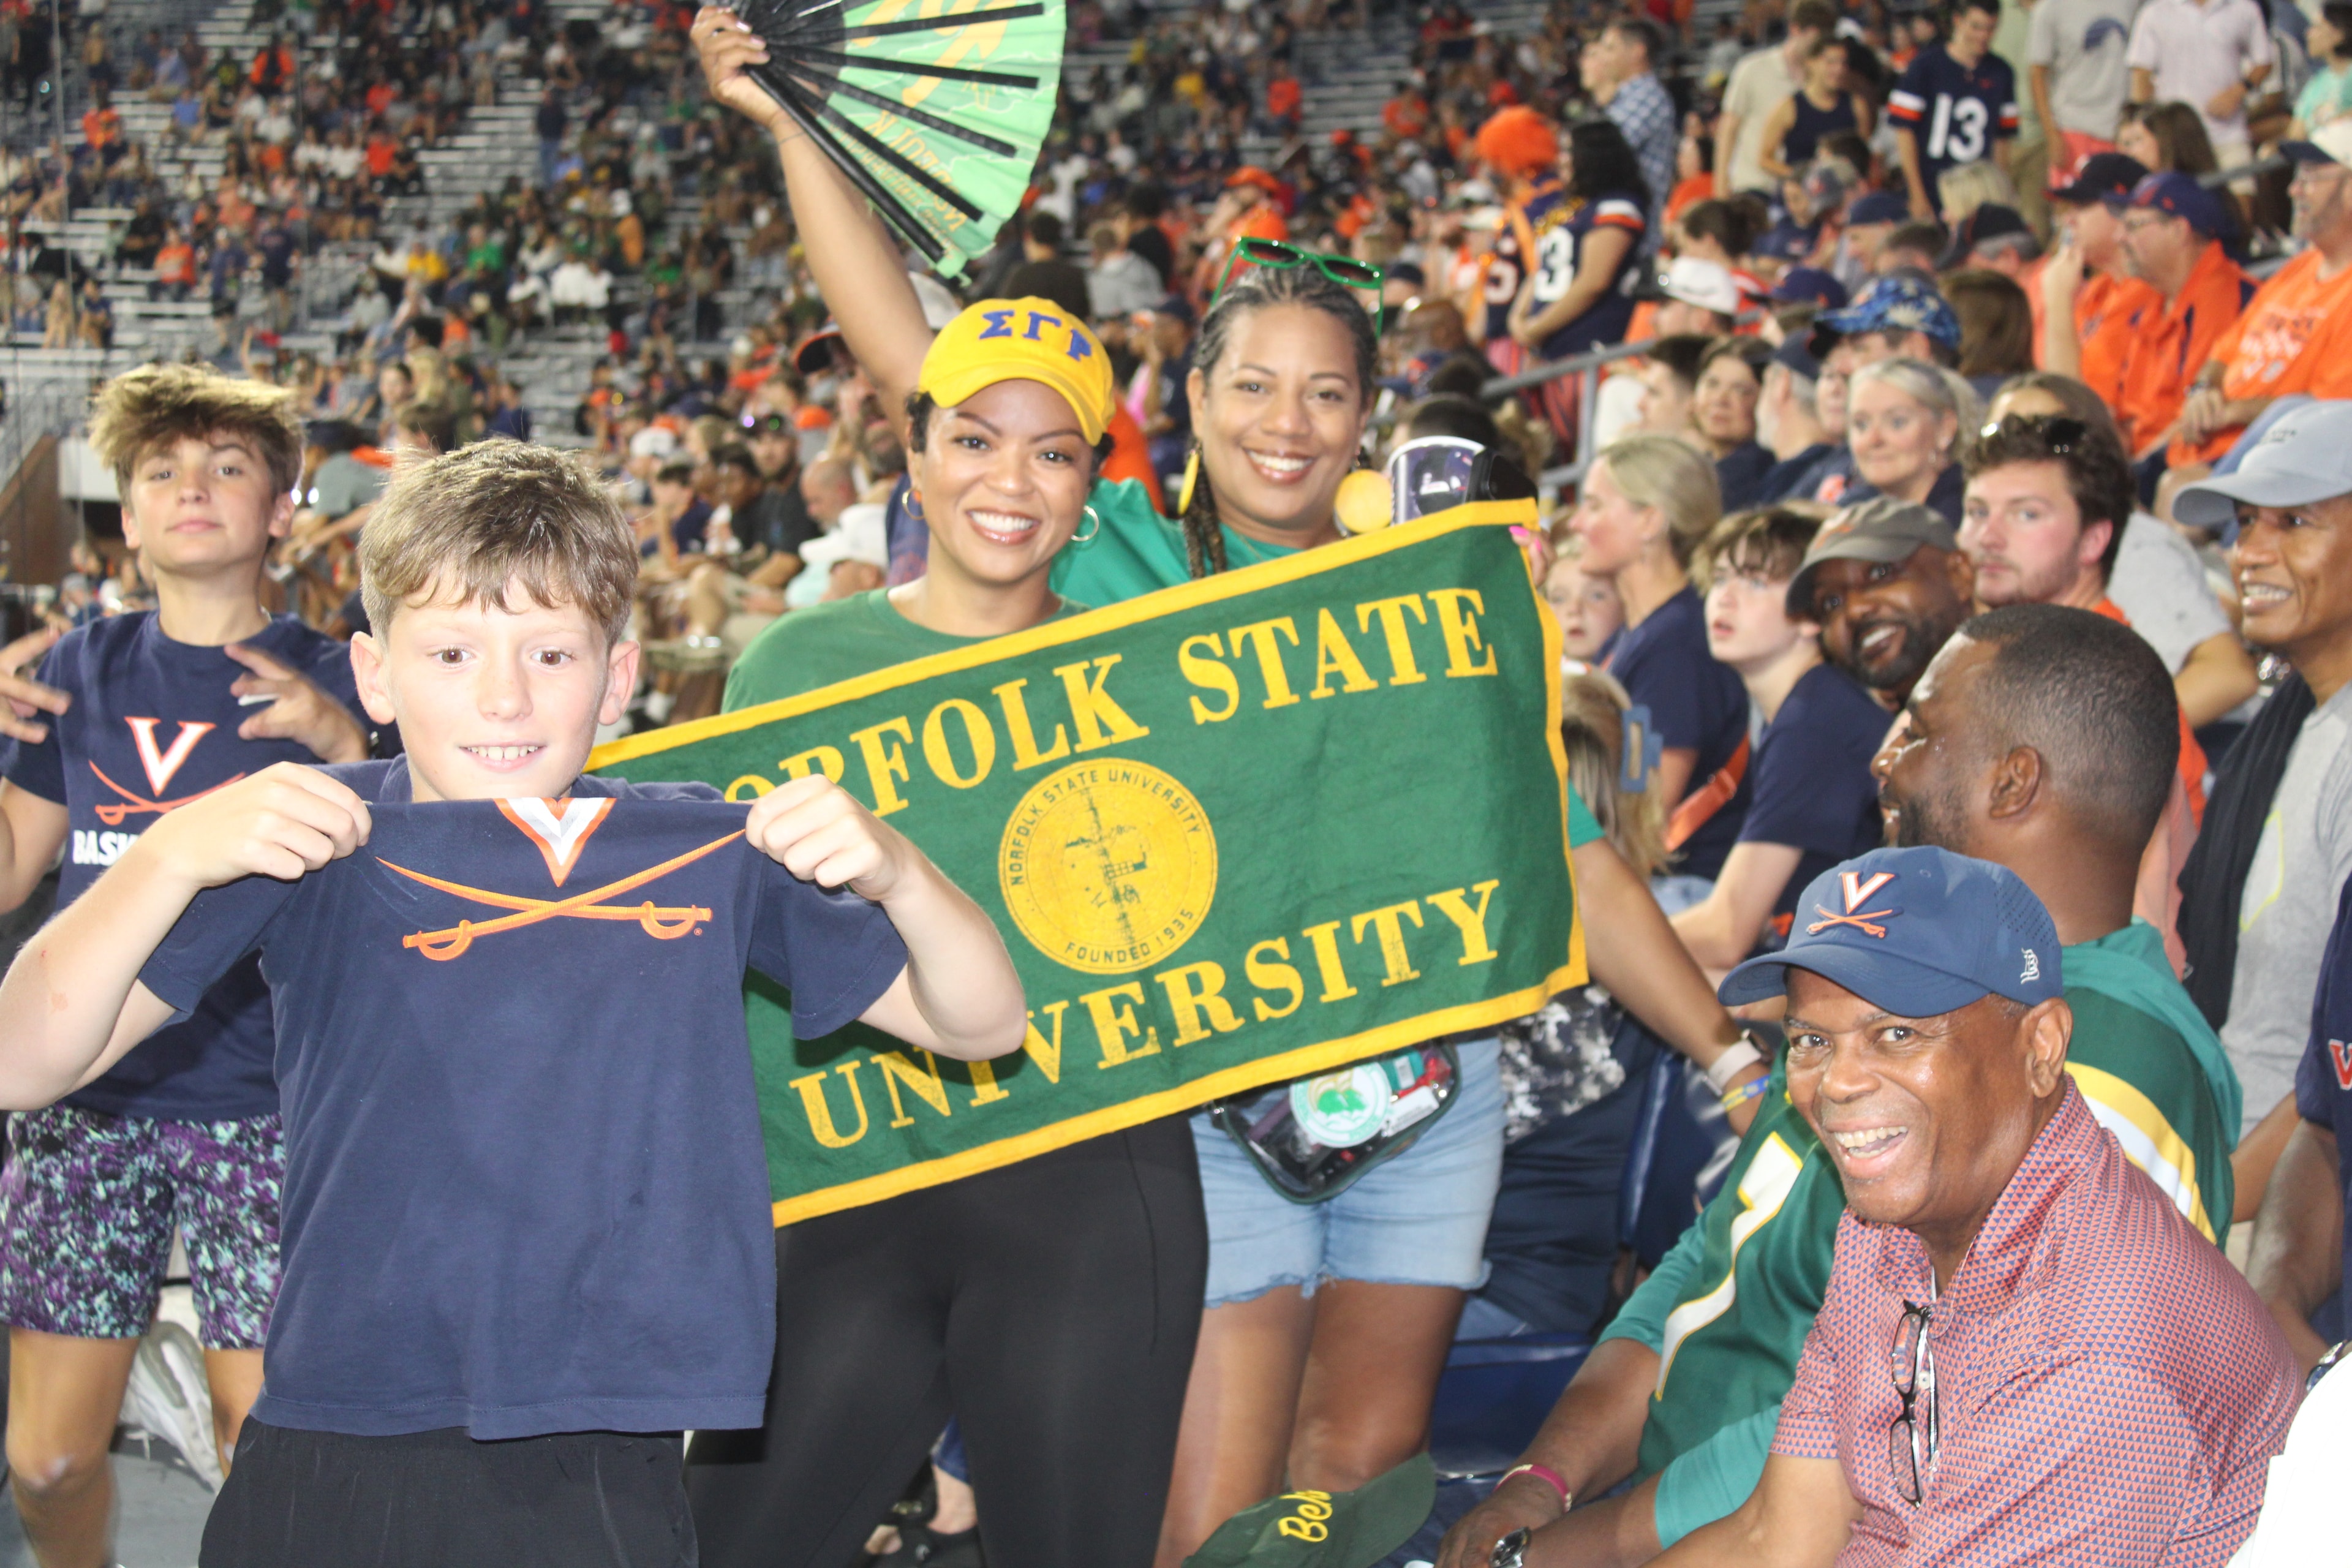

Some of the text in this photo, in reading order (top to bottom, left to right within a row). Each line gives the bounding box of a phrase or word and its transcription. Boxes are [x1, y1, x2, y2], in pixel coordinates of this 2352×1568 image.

[1928, 93, 1988, 162] 13
[1178, 588, 1498, 725] STATE
[124, 716, 216, 796] V
[1009, 769, 1202, 886] NORFOLK STATE UNIVERSITY
[1841, 872, 1894, 913] V
[1065, 909, 1194, 963] FOUNDED 1935
[789, 879, 1500, 1149] UNIVERSITY
